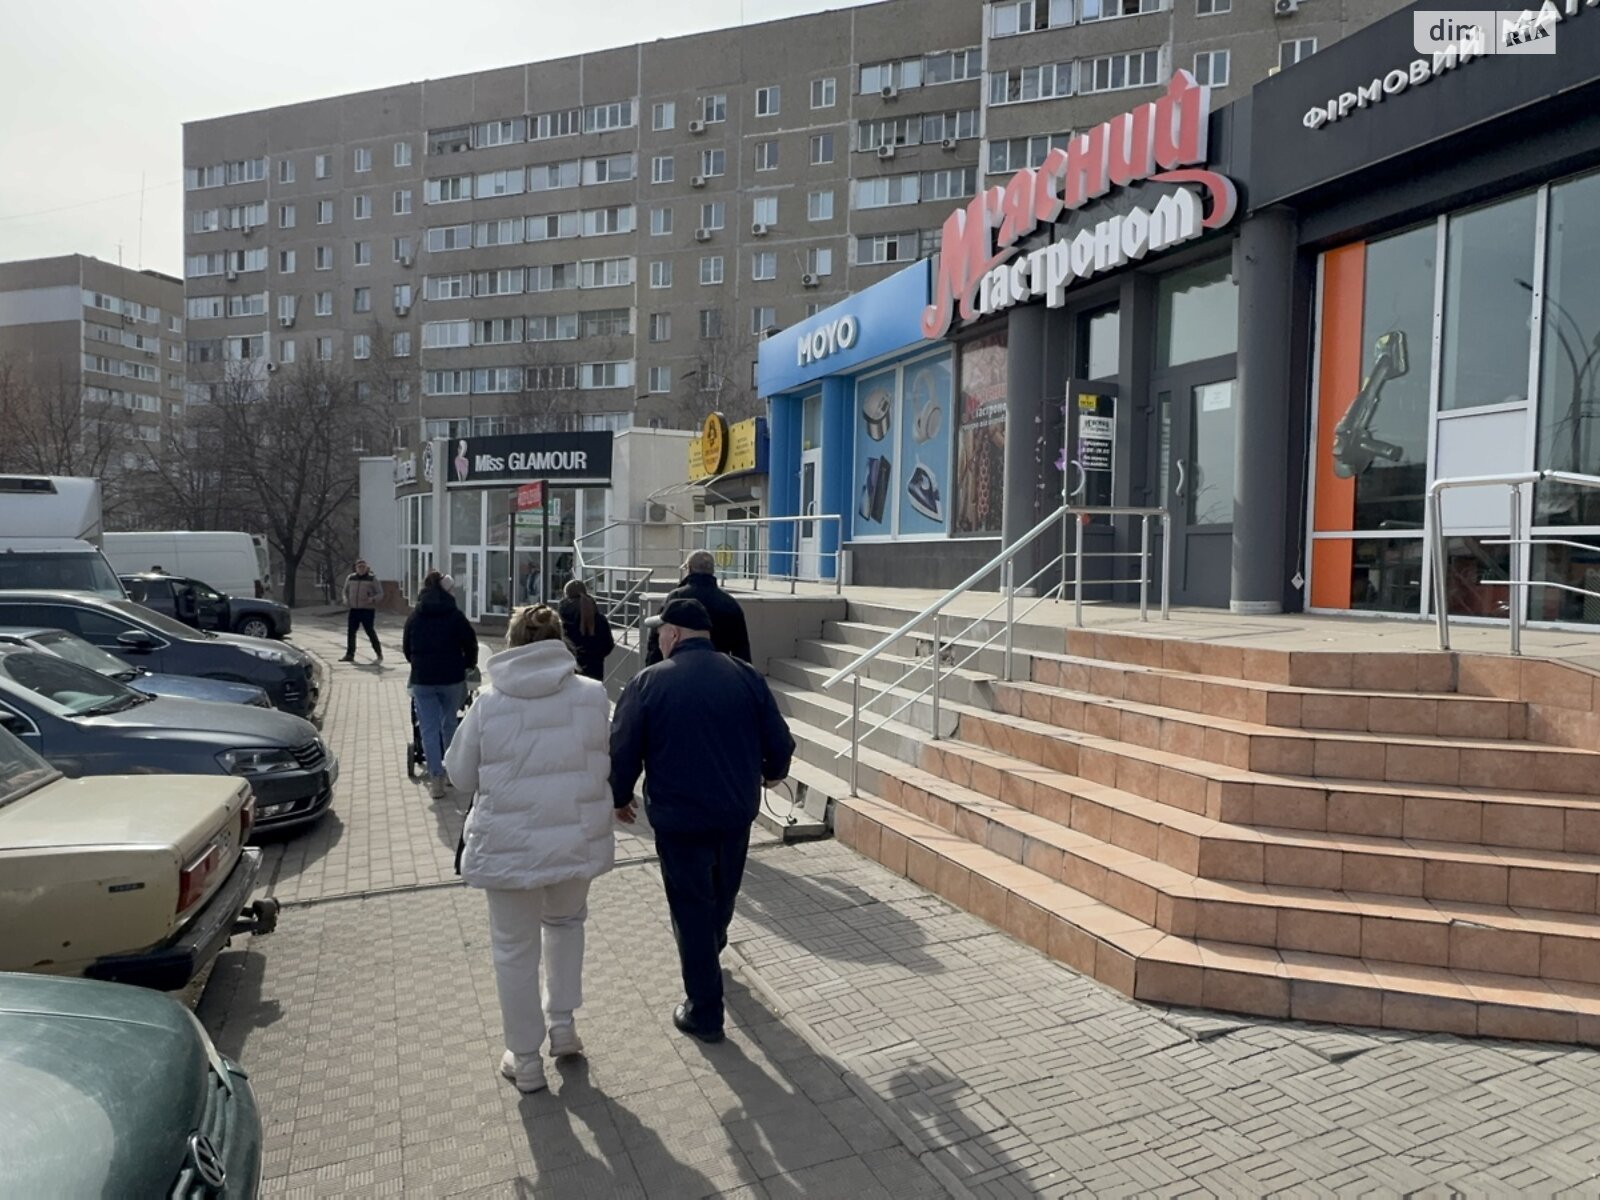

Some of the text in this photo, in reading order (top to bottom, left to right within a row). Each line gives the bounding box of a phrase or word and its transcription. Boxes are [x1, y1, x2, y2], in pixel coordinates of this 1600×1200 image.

[979, 186, 1203, 315] гастроном
[796, 314, 859, 367] MOYO
[507, 451, 588, 471] GLAMOUR
